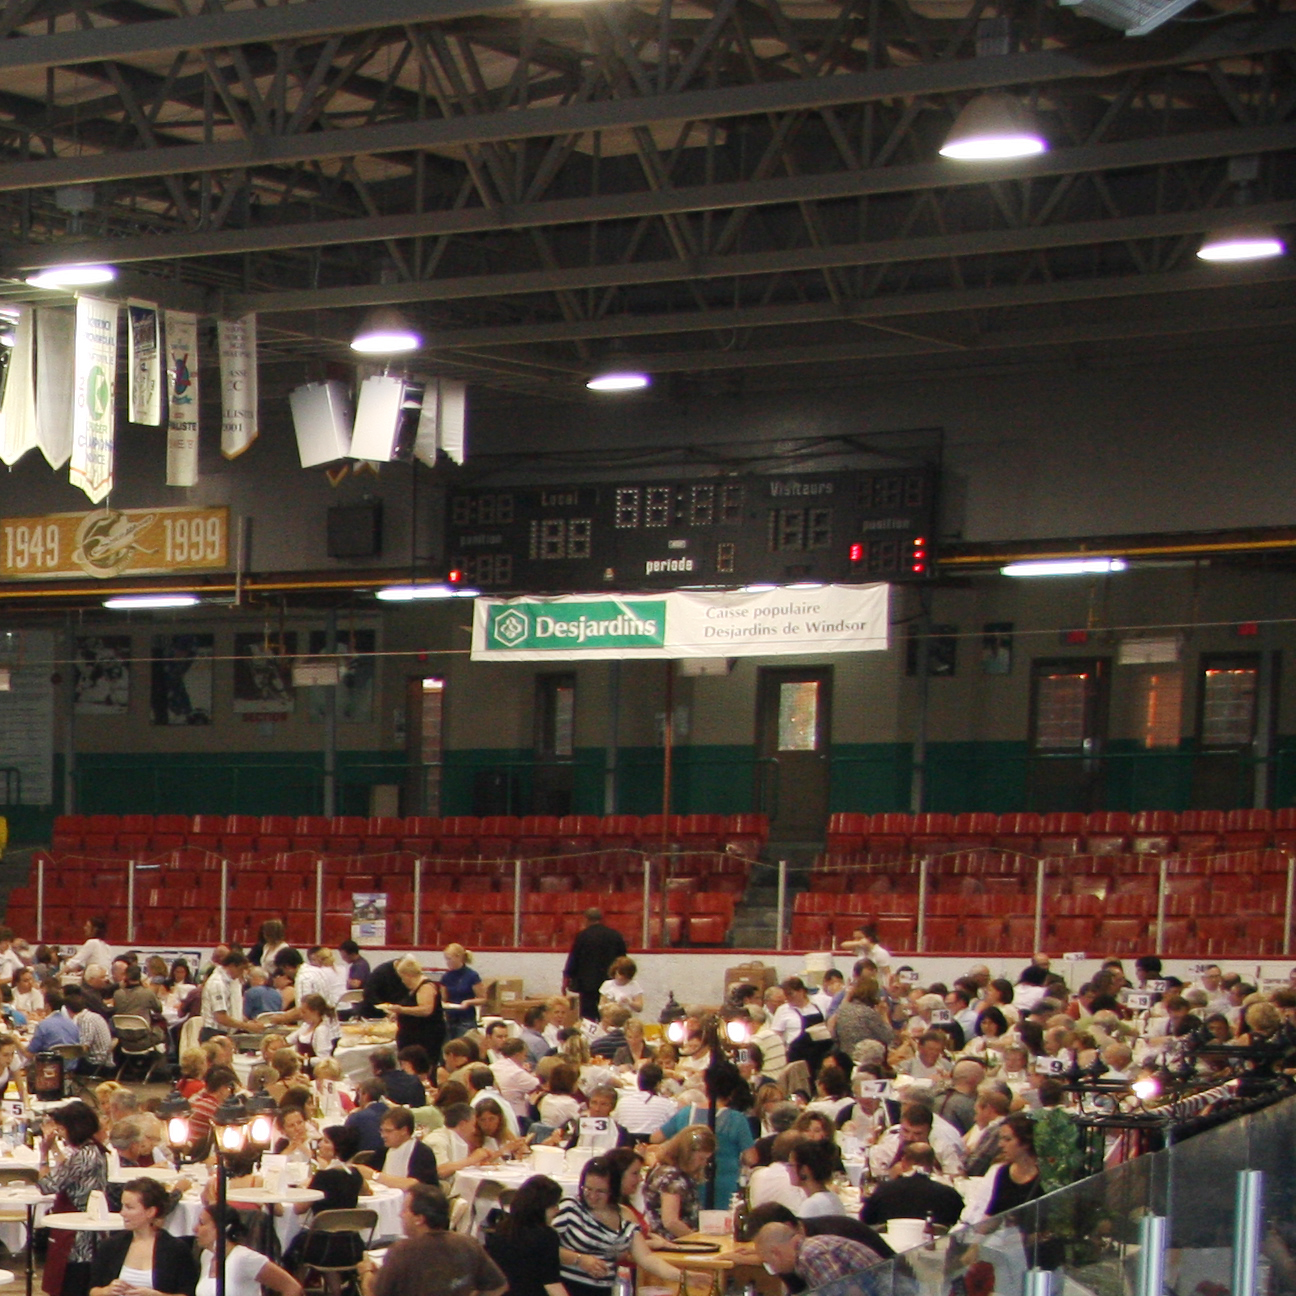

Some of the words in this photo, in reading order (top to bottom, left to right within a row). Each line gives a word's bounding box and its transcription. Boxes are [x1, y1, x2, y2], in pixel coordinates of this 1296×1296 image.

[4, 524, 59, 569] 1949
[163, 517, 221, 562] 1999
[706, 606, 750, 620] Caisse
[753, 601, 821, 623] populaire
[535, 604, 657, 643] Desjardins
[704, 620, 778, 640] Desjardins
[782, 620, 801, 635] de
[804, 617, 867, 635] Windsor
[874, 1081, 887, 1093] 7
[13, 1104, 22, 1116] 5
[595, 1120, 607, 1131] 3
